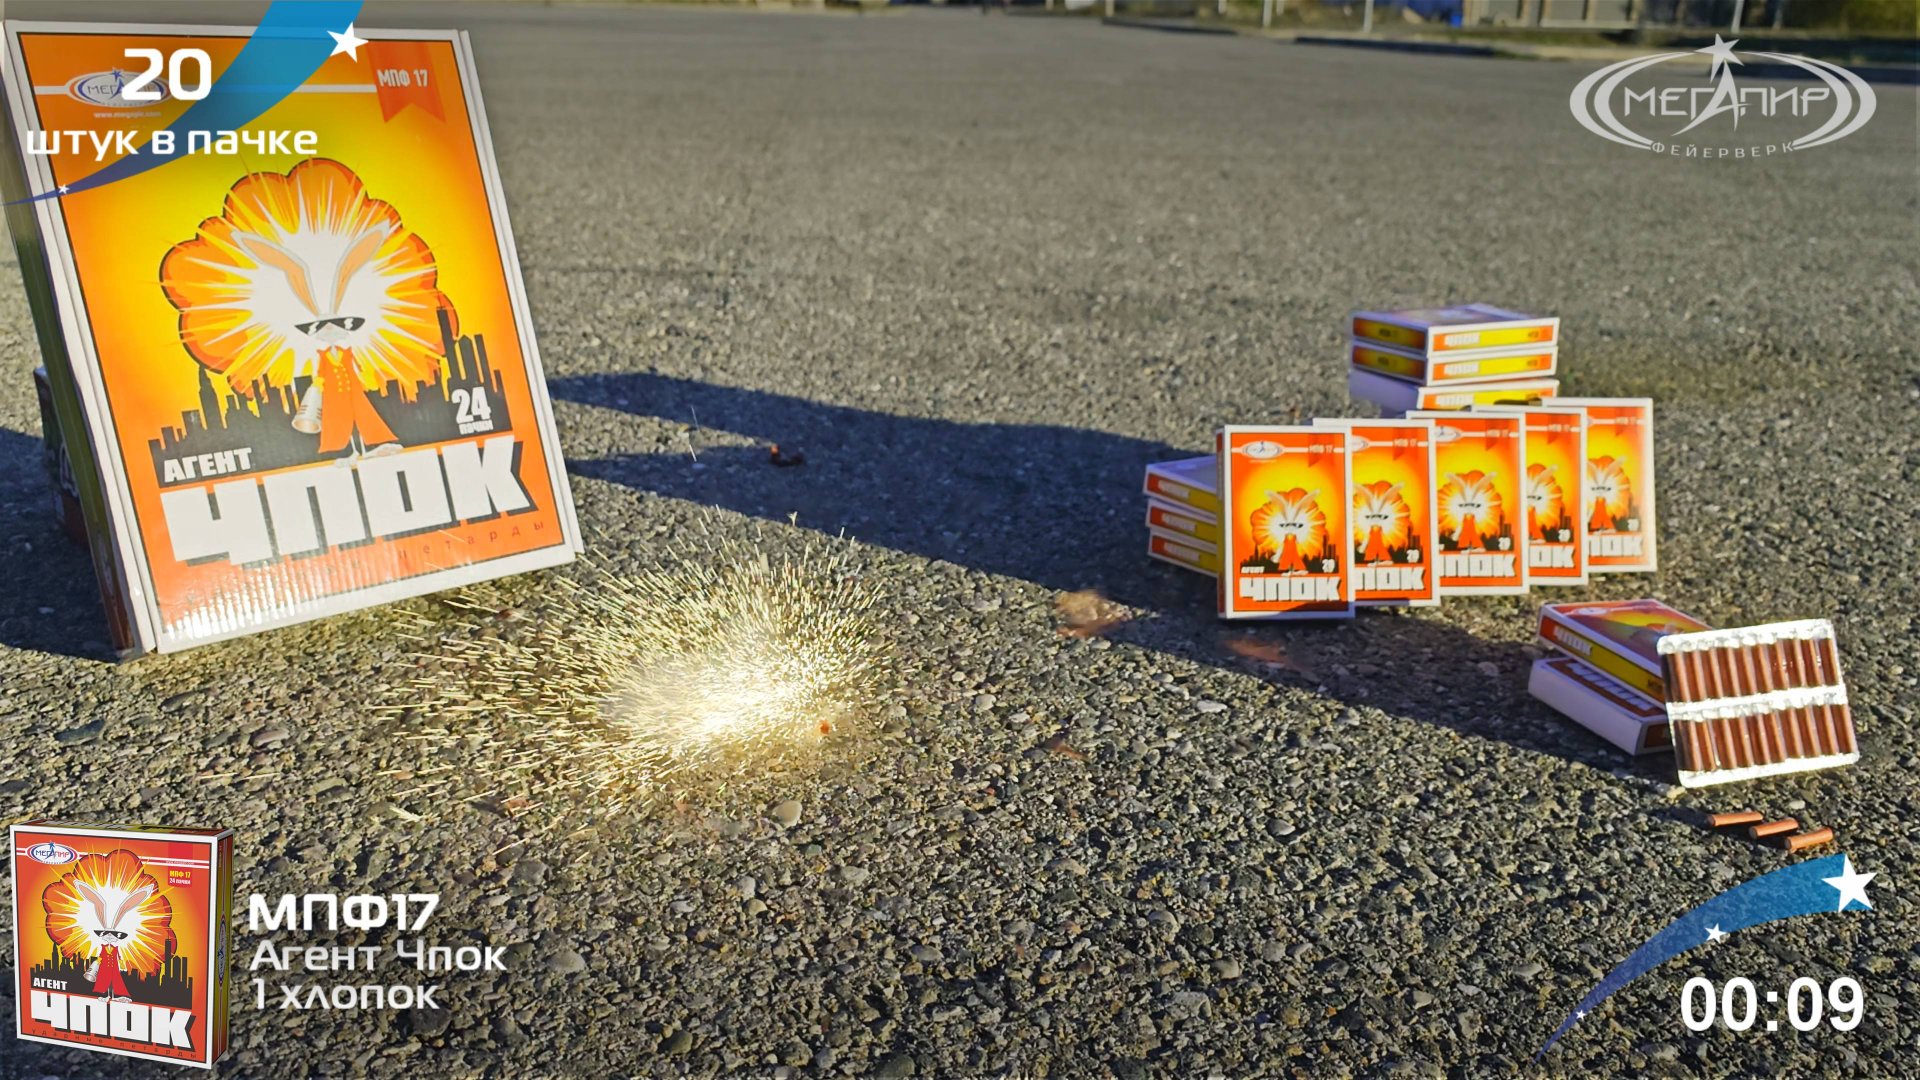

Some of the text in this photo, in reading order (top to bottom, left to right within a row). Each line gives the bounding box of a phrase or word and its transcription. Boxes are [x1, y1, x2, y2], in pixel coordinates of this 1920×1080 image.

[377, 69, 428, 87] МПФ 17
[451, 386, 492, 425] 24
[164, 447, 253, 482] АГЕНТ
[160, 435, 537, 567] ЧПОК
[1322, 558, 1336, 573] 20
[1440, 554, 1516, 578] ПОК
[1239, 576, 1342, 601] ЧПОК
[1355, 566, 1426, 591] ПОК
[170, 870, 191, 879] МПФ 17
[33, 977, 67, 990] АГЕНТ
[30, 989, 196, 1051] ЧПОК
